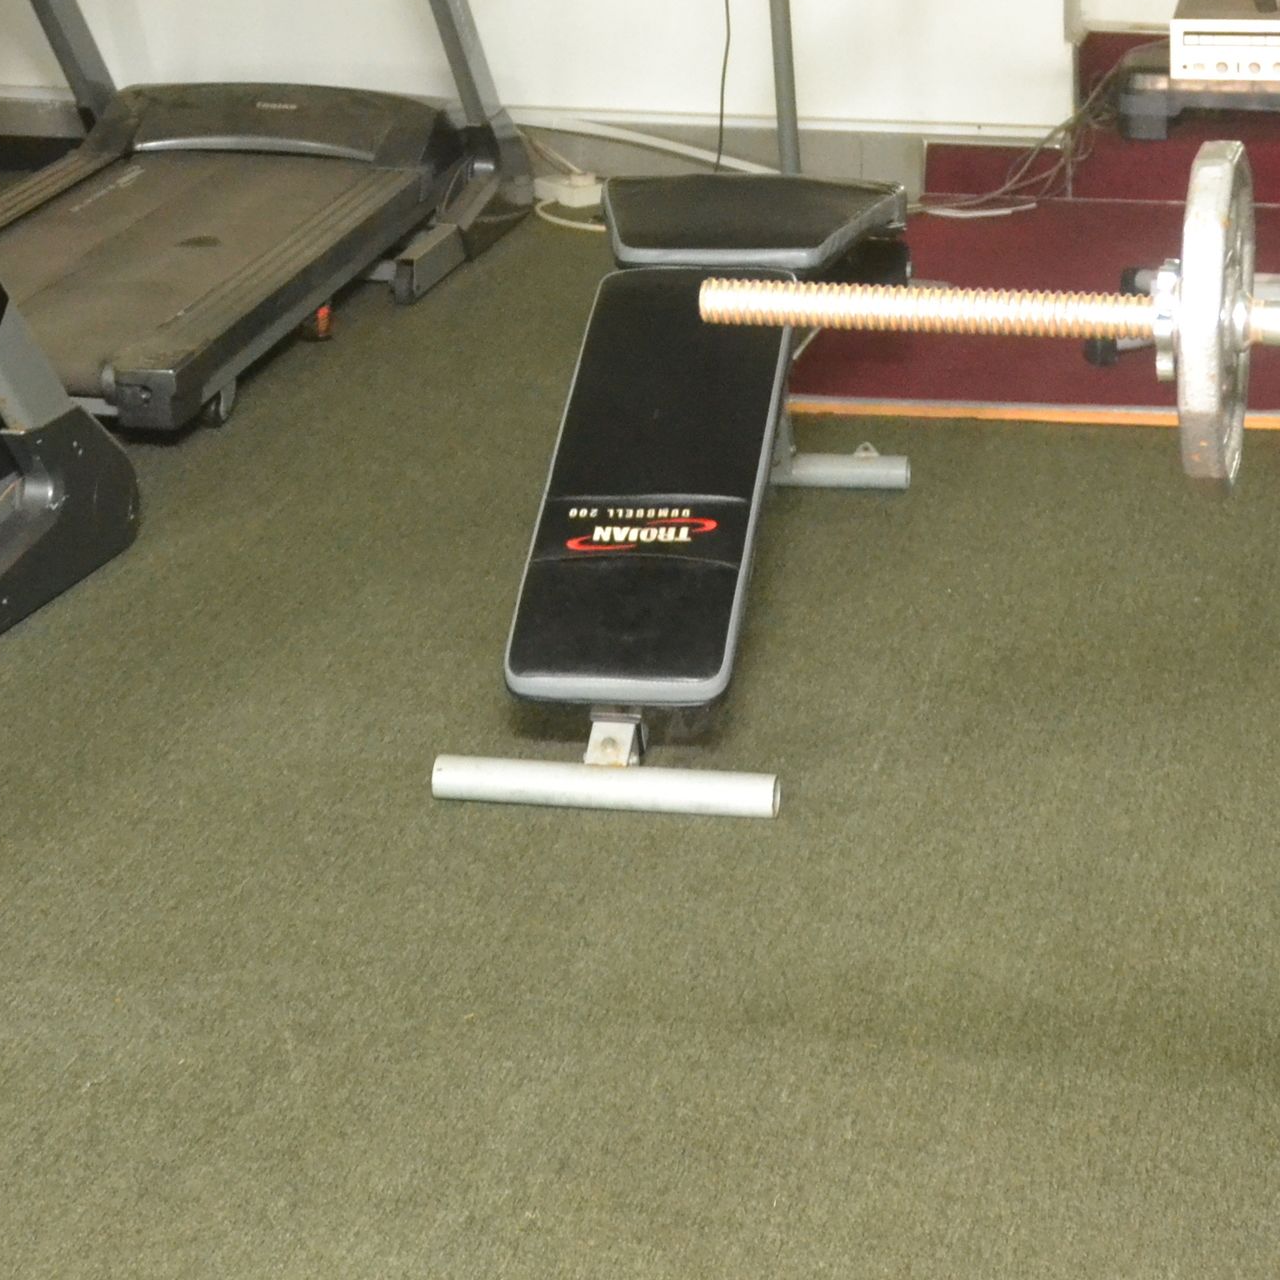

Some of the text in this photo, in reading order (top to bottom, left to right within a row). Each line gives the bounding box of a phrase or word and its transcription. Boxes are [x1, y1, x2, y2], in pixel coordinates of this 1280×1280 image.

[568, 508, 691, 518] DUMBBELL 200
[592, 525, 692, 542] TROJAN
